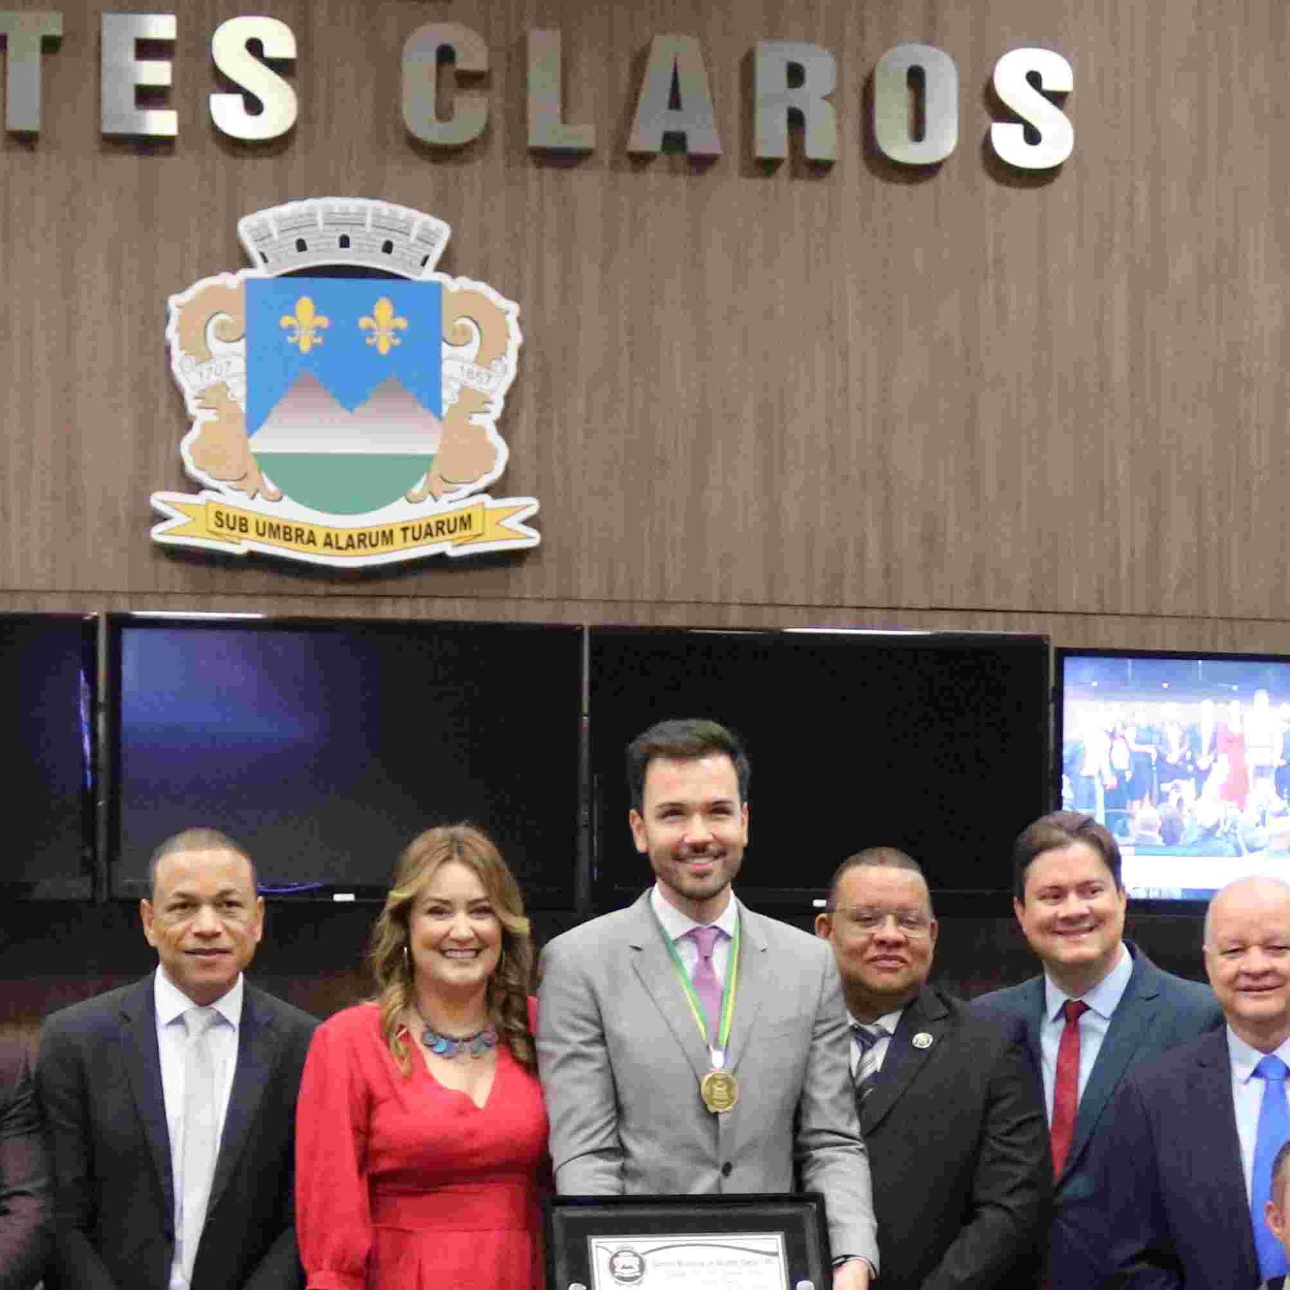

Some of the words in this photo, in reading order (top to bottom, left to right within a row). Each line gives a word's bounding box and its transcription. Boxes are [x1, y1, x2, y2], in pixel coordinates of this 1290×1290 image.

[400, 21, 1075, 171] CLAROS
[213, 509, 249, 534] SUB
[255, 518, 318, 547] UMBRA
[322, 525, 395, 551] ALARUM
[401, 513, 473, 544] TUARUM
